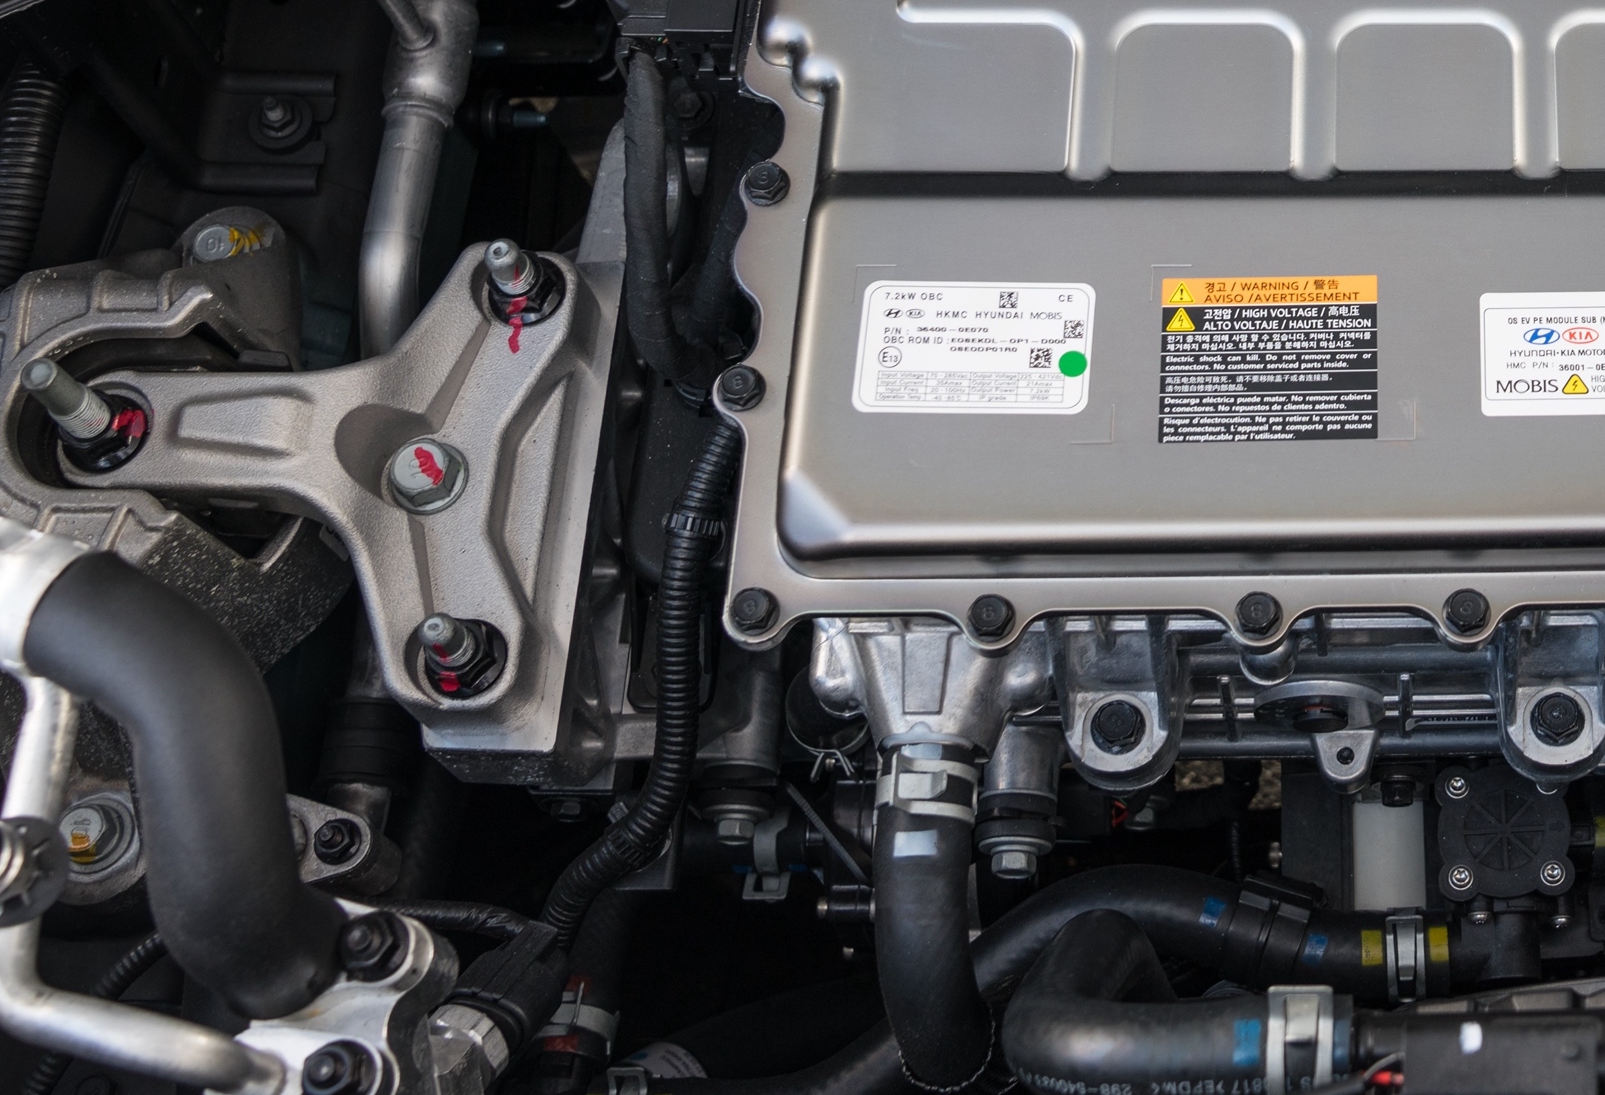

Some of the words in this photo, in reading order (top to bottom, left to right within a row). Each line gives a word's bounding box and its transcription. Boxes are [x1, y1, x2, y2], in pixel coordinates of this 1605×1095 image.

[1204, 281, 1227, 293] 경고
[1240, 281, 1300, 292] WARNING
[1313, 279, 1340, 291] 警告
[885, 292, 917, 301] 7.2kW
[920, 292, 944, 301] OBC
[1058, 294, 1074, 303] CE
[1204, 293, 1244, 304] AVISO
[936, 310, 968, 319] HKMC
[975, 311, 1024, 320] HYUNDAI
[1029, 311, 1063, 321] MOBIS
[1203, 307, 1232, 320] 고전압
[1242, 307, 1269, 318] HIGH
[1270, 306, 1319, 318] VOLTAGE
[1327, 305, 1360, 318] 高电压
[1203, 320, 1232, 331] ALTO
[1233, 319, 1279, 331] VOLTAJE
[1288, 318, 1325, 329] HAUTE
[1327, 317, 1372, 329] TENSION
[1521, 317, 1532, 325] EV
[1533, 316, 1544, 325] PE
[1546, 316, 1580, 325] MODULE
[1580, 316, 1598, 324] SUB
[884, 327, 902, 336] P/N
[1568, 331, 1593, 341] KIA
[883, 335, 905, 344] OBC
[908, 336, 930, 345] ROM
[933, 336, 943, 345] ID
[1165, 355, 1195, 363] Electric
[1199, 355, 1223, 363] shock
[1246, 353, 1261, 362] kill.
[1265, 354, 1278, 362] Do
[1282, 353, 1297, 361] not
[1300, 353, 1331, 361] remove
[1335, 352, 1358, 360] cover
[1362, 352, 1372, 360] or
[1165, 363, 1212, 372] connectors.
[1213, 363, 1226, 371] No
[1227, 362, 1265, 371] customer
[1266, 361, 1299, 370] serviced
[1300, 361, 1322, 370] parts
[1323, 360, 1350, 369] inside.
[1506, 361, 1527, 370] HMC
[1532, 361, 1549, 369] P/N
[1495, 378, 1559, 394] MOBIS
[1164, 396, 1200, 406] Descarga
[1201, 395, 1235, 405] eléctrica
[1236, 395, 1262, 405] puede
[1263, 395, 1289, 403] matar.
[1290, 394, 1303, 402] No
[1305, 394, 1339, 402] remover
[1339, 393, 1372, 401] cubierta
[1171, 405, 1217, 413] conectores.
[1217, 404, 1231, 412] No
[1231, 404, 1270, 413] repuestos
[1271, 403, 1282, 411] de
[1283, 402, 1313, 410] clientes
[1314, 402, 1348, 410] adentro.
[1163, 417, 1190, 426] Risque
[1254, 415, 1267, 423] Ne
[1268, 415, 1284, 424] pas
[1285, 414, 1310, 423] retirer
[1312, 414, 1320, 422] le
[1322, 413, 1360, 422] couvercle
[1361, 413, 1373, 421] ou
[1162, 426, 1175, 434] les
[1177, 425, 1228, 434] connecteurs.
[1230, 424, 1269, 434] L'appareil
[1271, 423, 1283, 431] ne
[1285, 422, 1324, 432] comporte
[1326, 422, 1342, 432] pas
[1344, 421, 1373, 430] aucune
[1162, 434, 1185, 444] piece
[1185, 433, 1234, 443] remplacable
[1234, 433, 1249, 442] par
